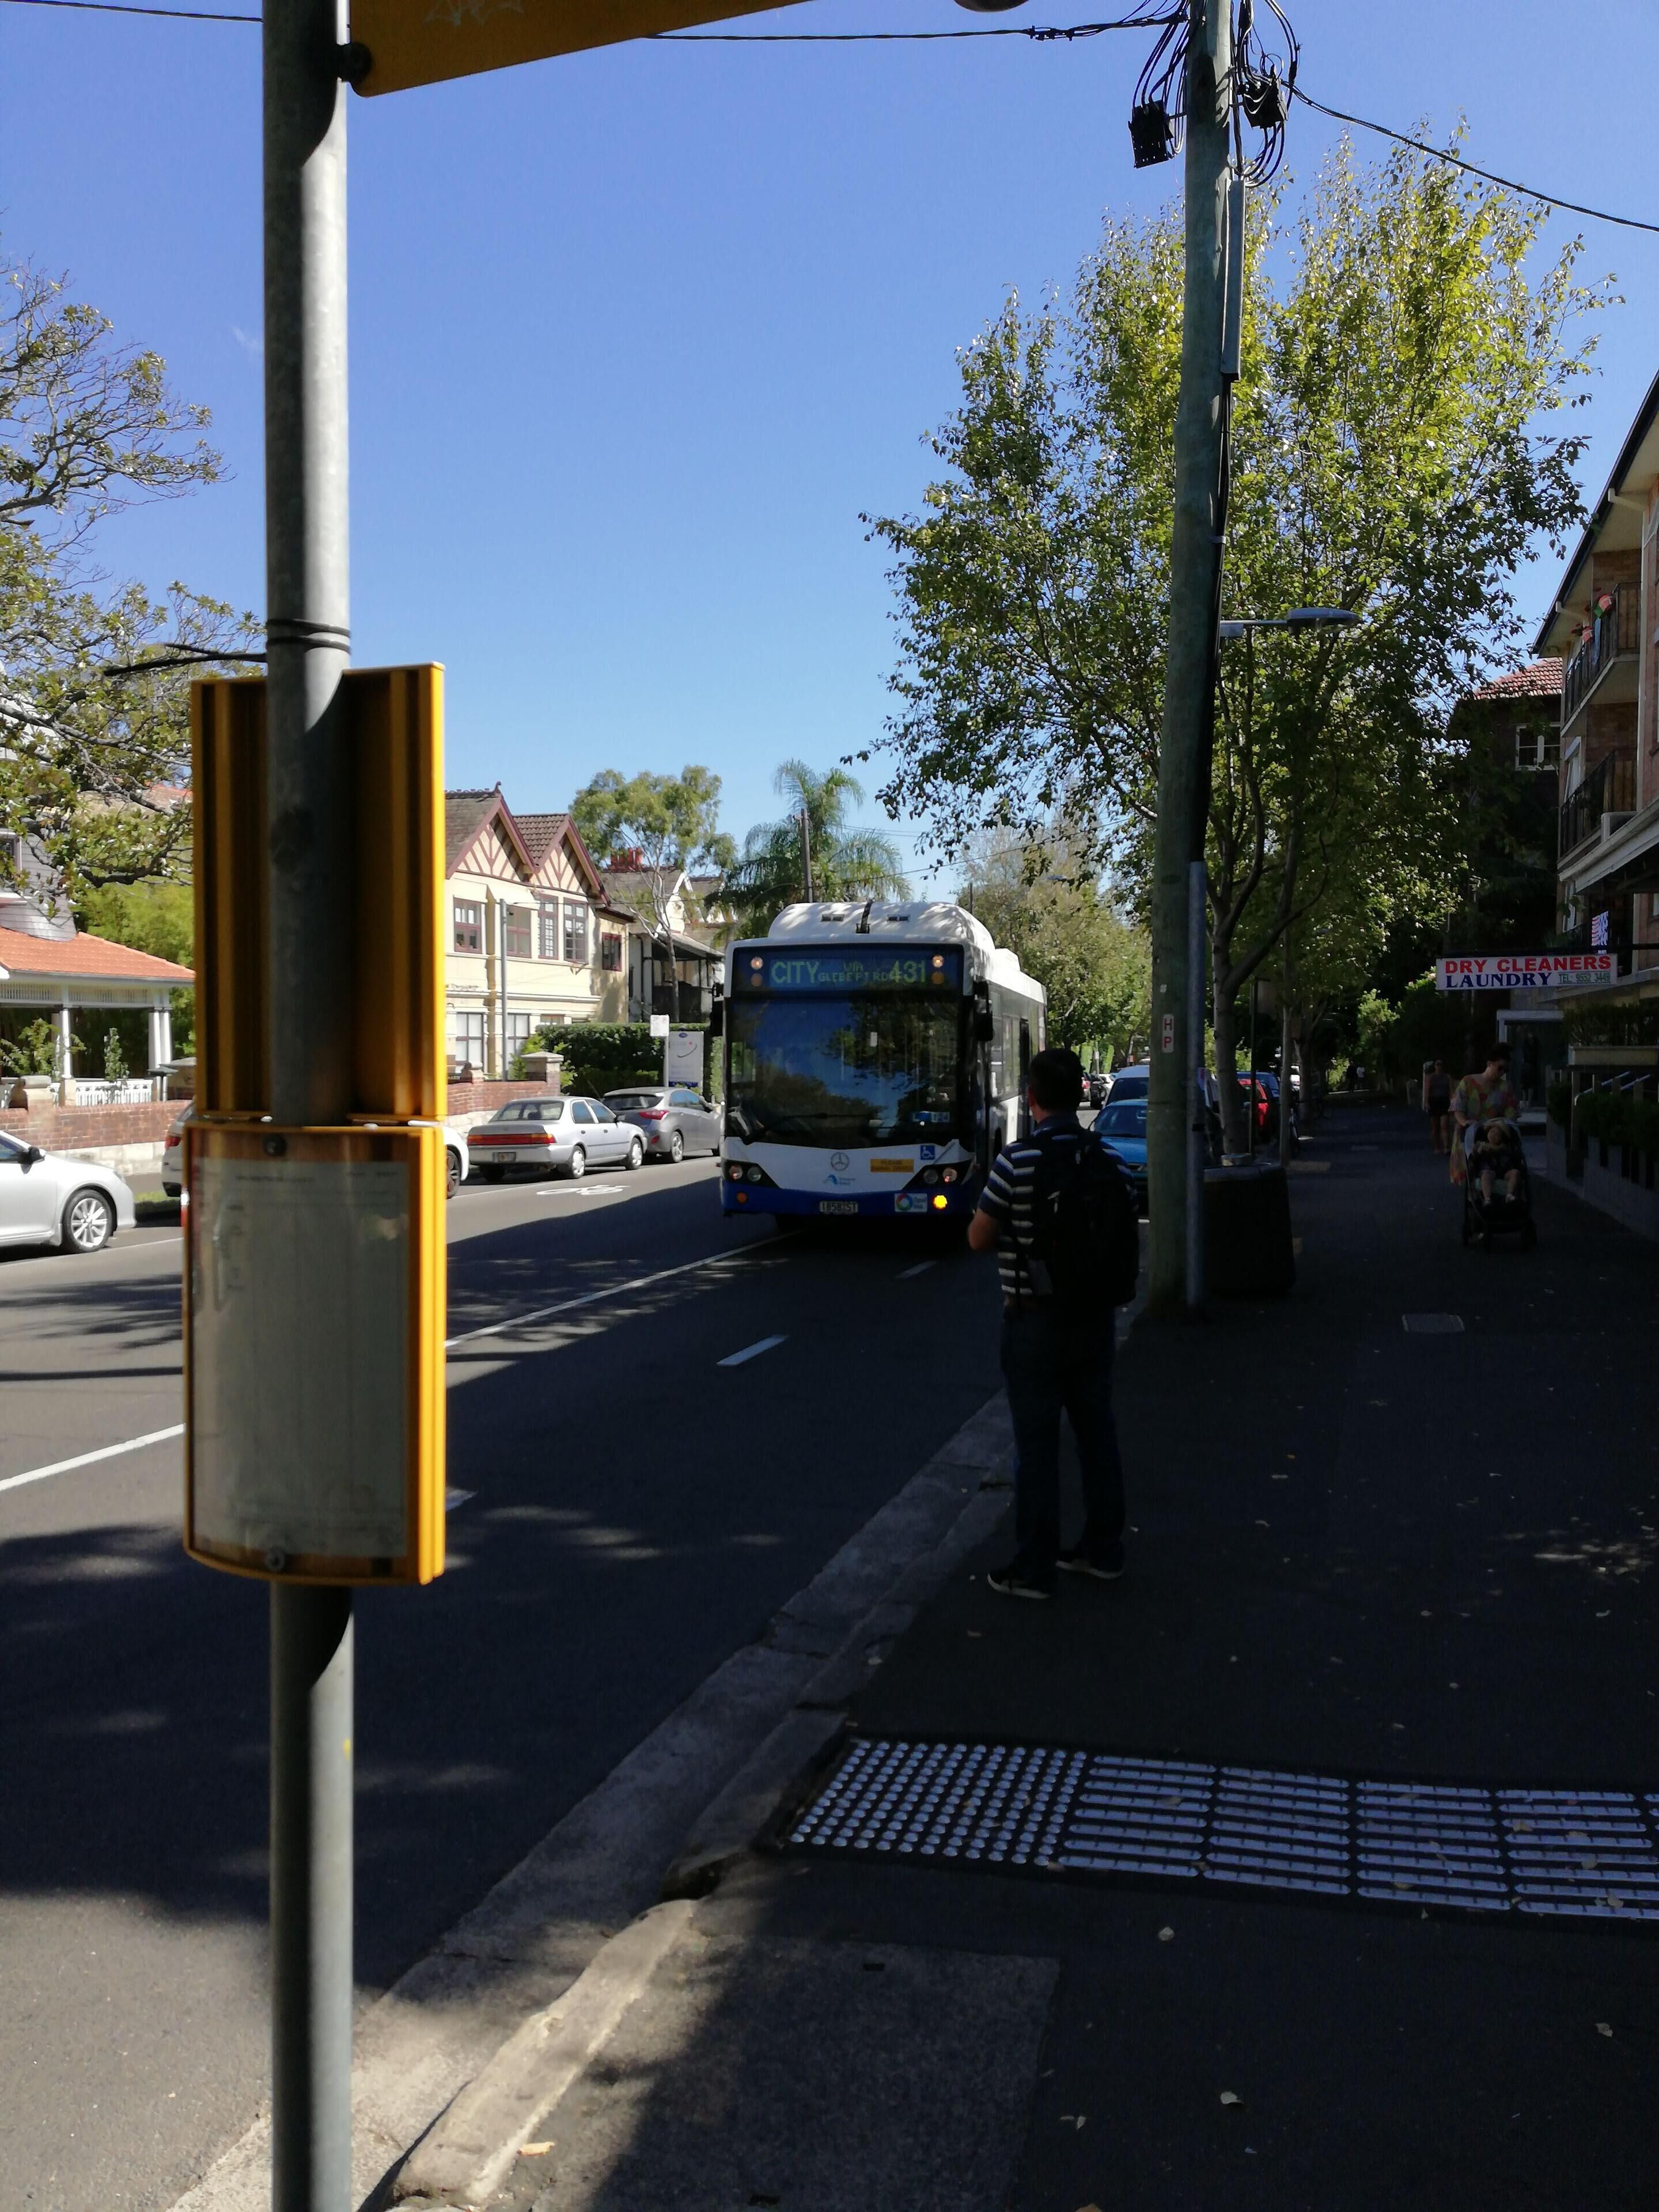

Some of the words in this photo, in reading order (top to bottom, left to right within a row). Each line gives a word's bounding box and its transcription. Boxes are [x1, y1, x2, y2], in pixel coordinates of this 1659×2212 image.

[771, 961, 820, 983] CITY
[889, 960, 926, 983] 431
[1445, 959, 1487, 974] DRY
[1497, 955, 1611, 972] CLEANERS
[818, 972, 853, 982] GLEBE
[873, 972, 889, 982] RD
[1446, 972, 1553, 988] LAUNDRY
[1559, 974, 1573, 983] TEL:
